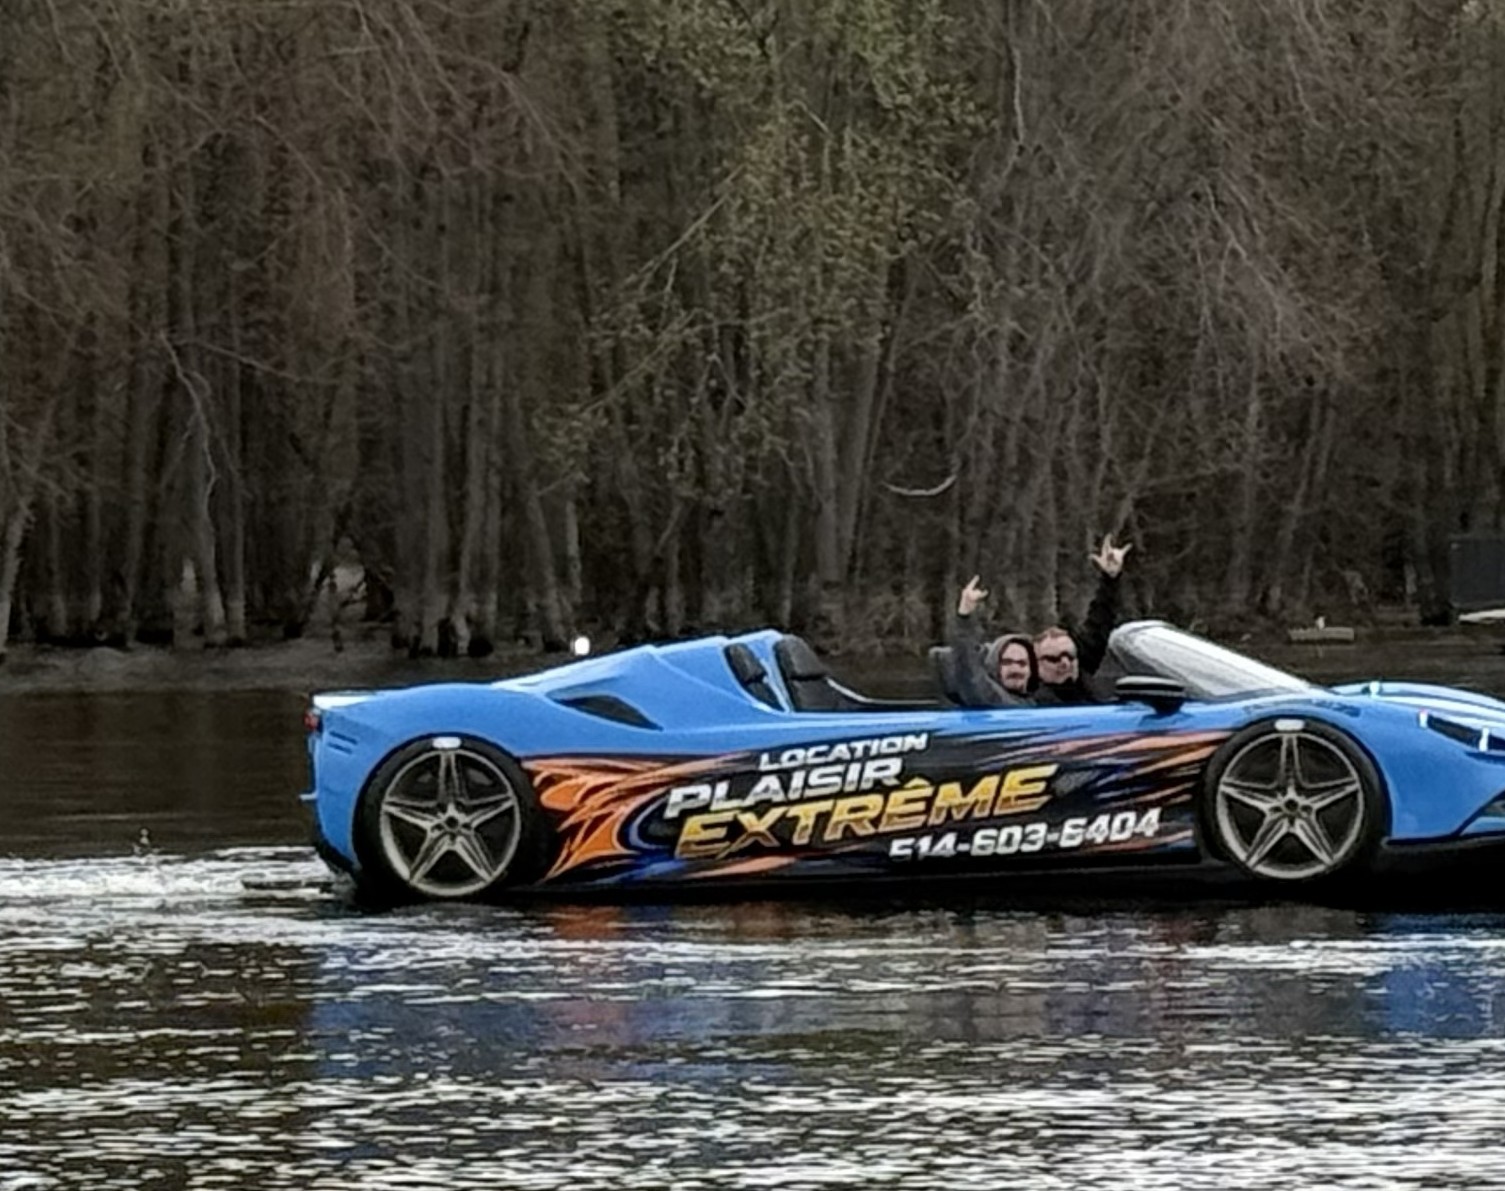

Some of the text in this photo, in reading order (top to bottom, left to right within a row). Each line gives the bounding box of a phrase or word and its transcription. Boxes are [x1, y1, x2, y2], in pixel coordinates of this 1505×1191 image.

[758, 732, 929, 772] LOCATION
[663, 757, 903, 819] PLAISIR
[673, 763, 1060, 859] EXTRÊME
[888, 806, 1162, 862] 514-603-6404
